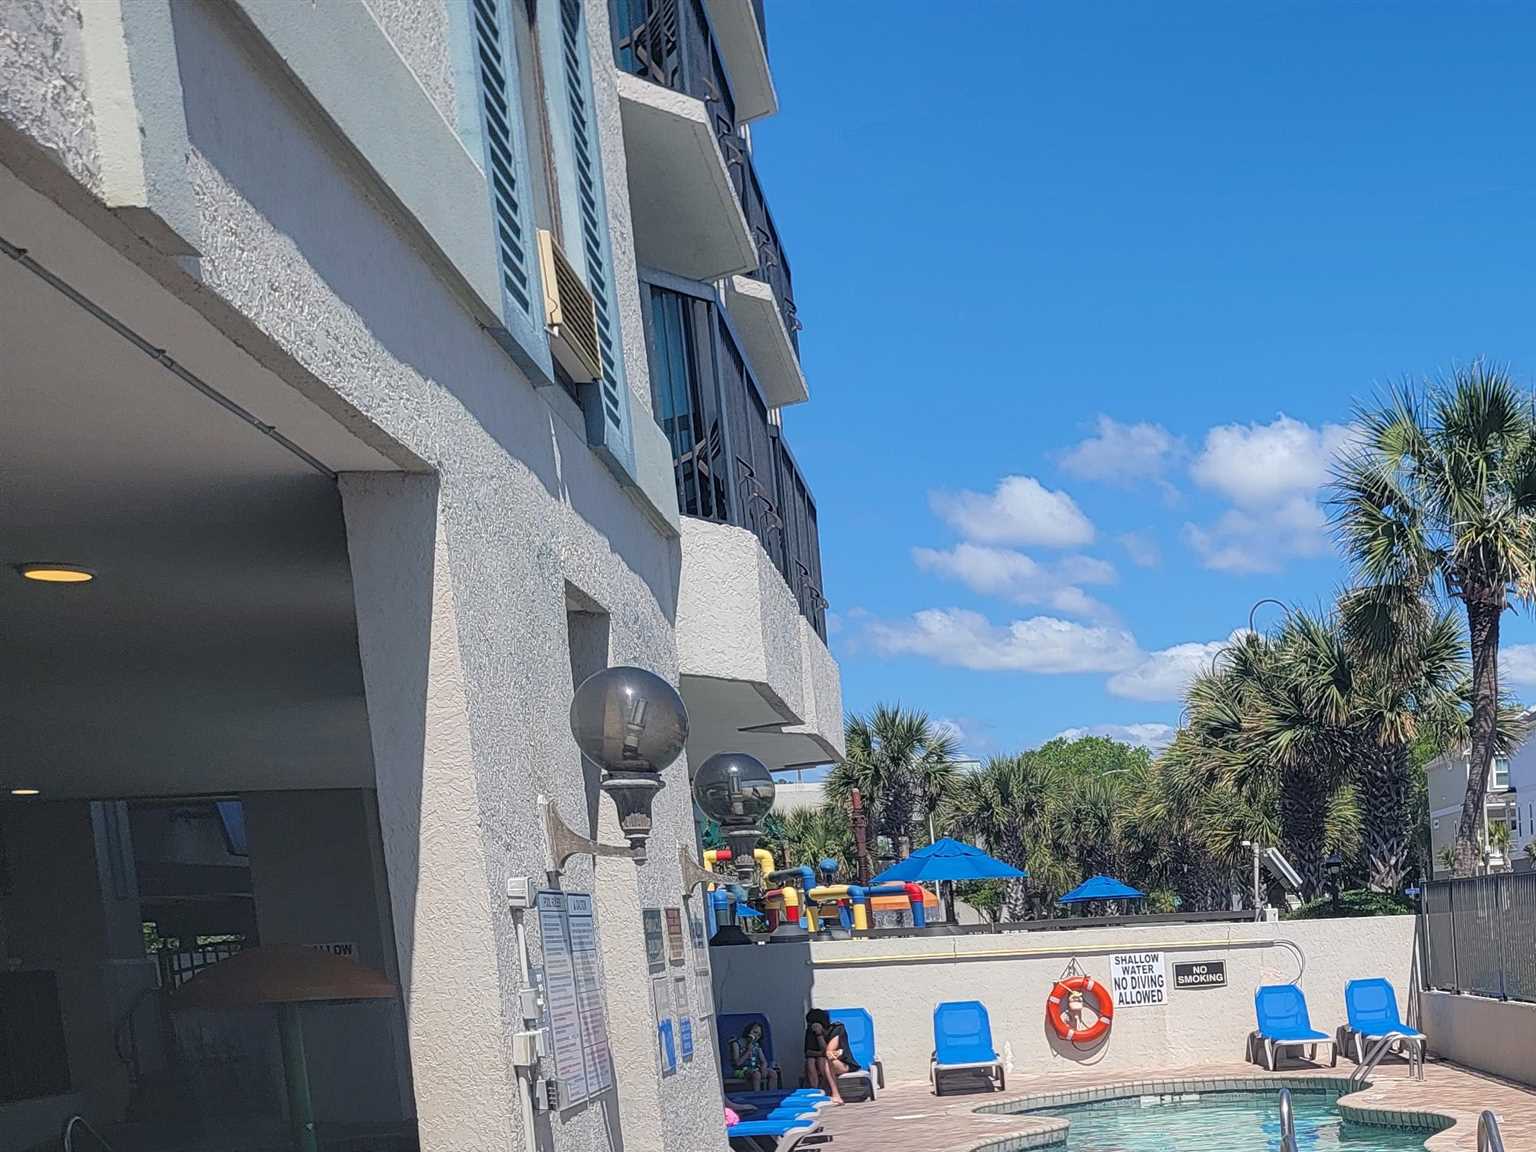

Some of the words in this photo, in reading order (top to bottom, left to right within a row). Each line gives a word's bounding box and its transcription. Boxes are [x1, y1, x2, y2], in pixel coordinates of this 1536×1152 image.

[1114, 954, 1159, 965] SHALLOW
[1122, 966, 1154, 976] WATER
[1193, 966, 1207, 974] NO
[1114, 977, 1128, 991] NO
[1131, 975, 1164, 989] DIVING
[1178, 974, 1223, 984] SMOKING
[1118, 990, 1163, 1005] ALLOWED
